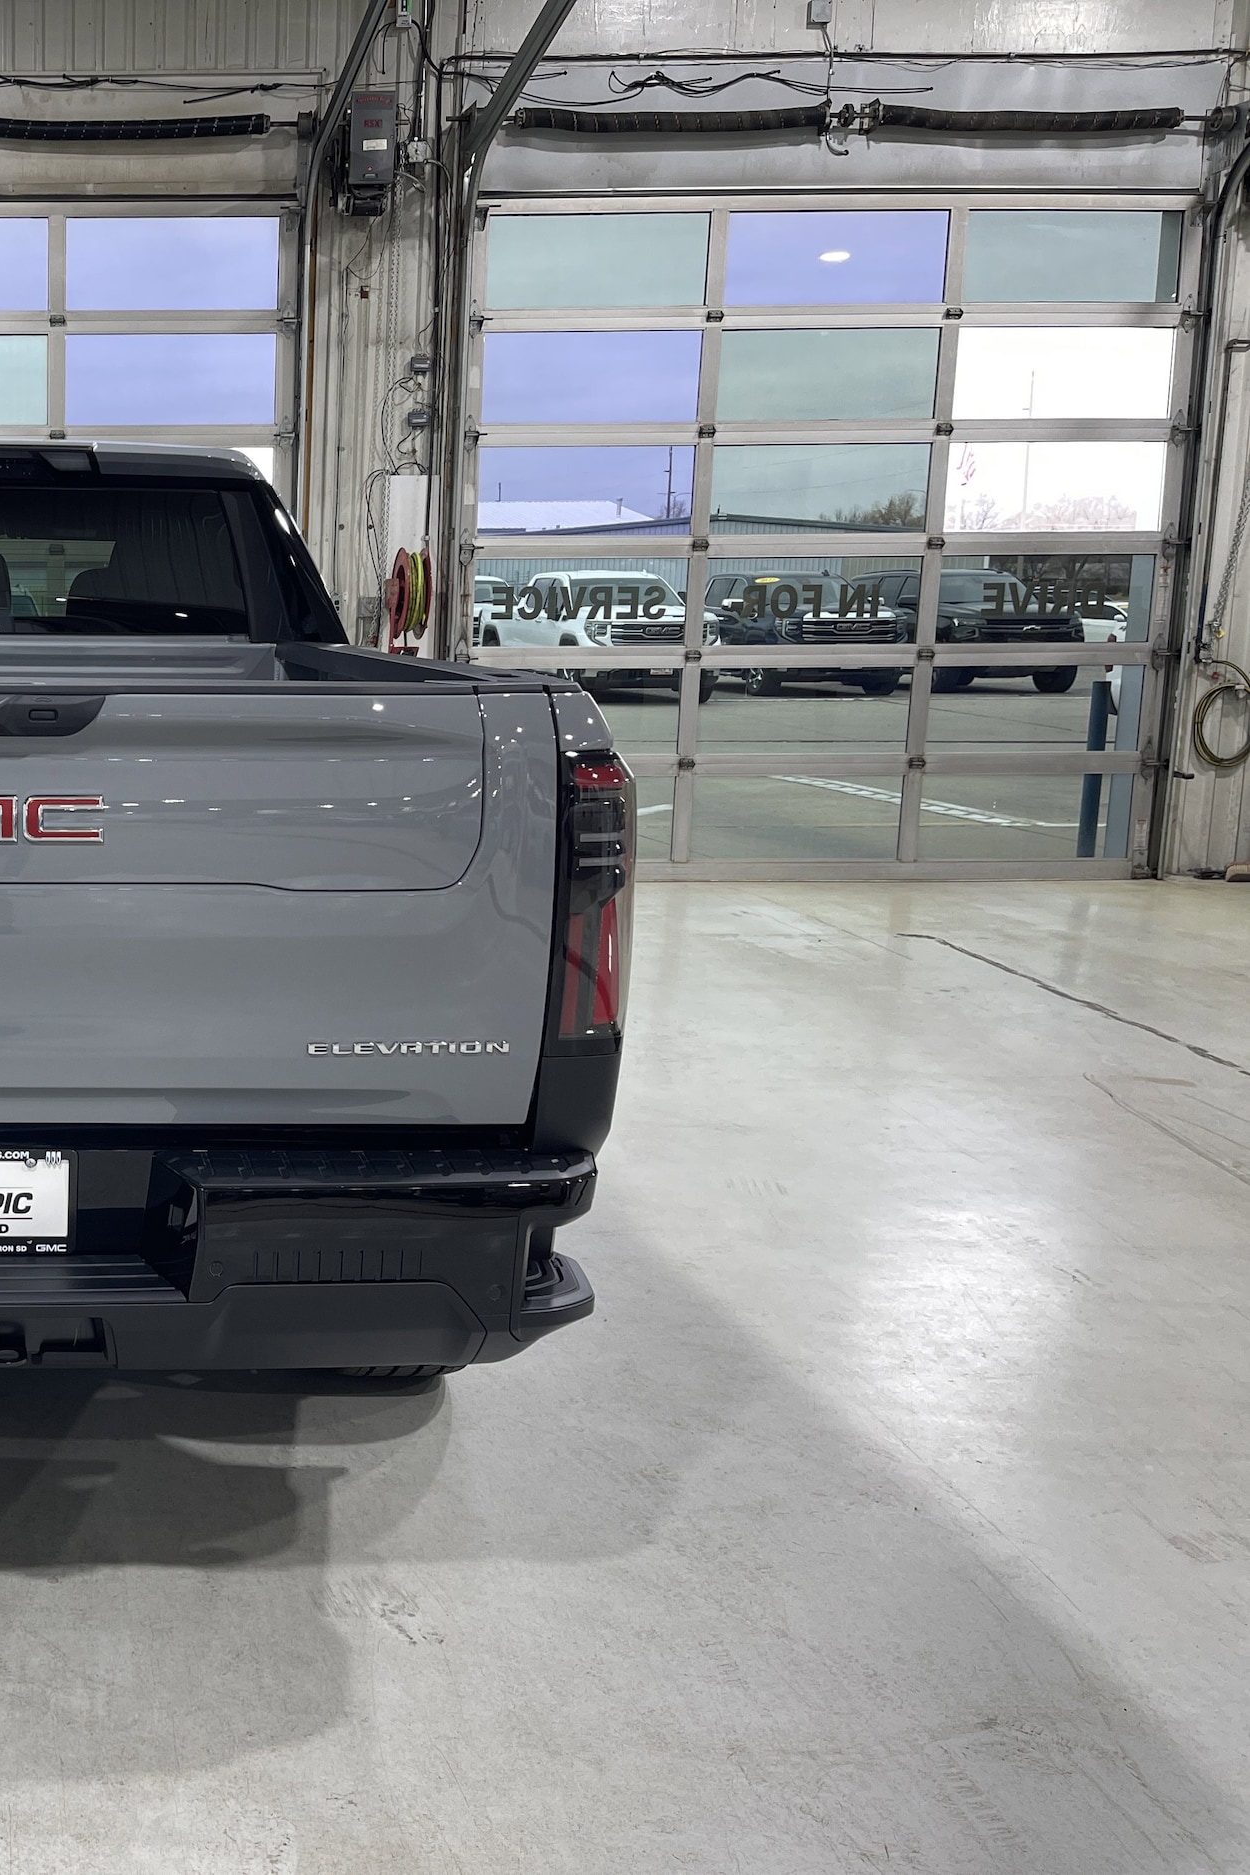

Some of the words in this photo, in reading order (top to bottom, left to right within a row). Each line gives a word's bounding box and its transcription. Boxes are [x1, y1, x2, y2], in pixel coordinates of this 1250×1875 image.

[307, 1041, 510, 1055] ELEVATION
[15, 1244, 28, 1253] SD
[35, 1244, 67, 1252] GMC
